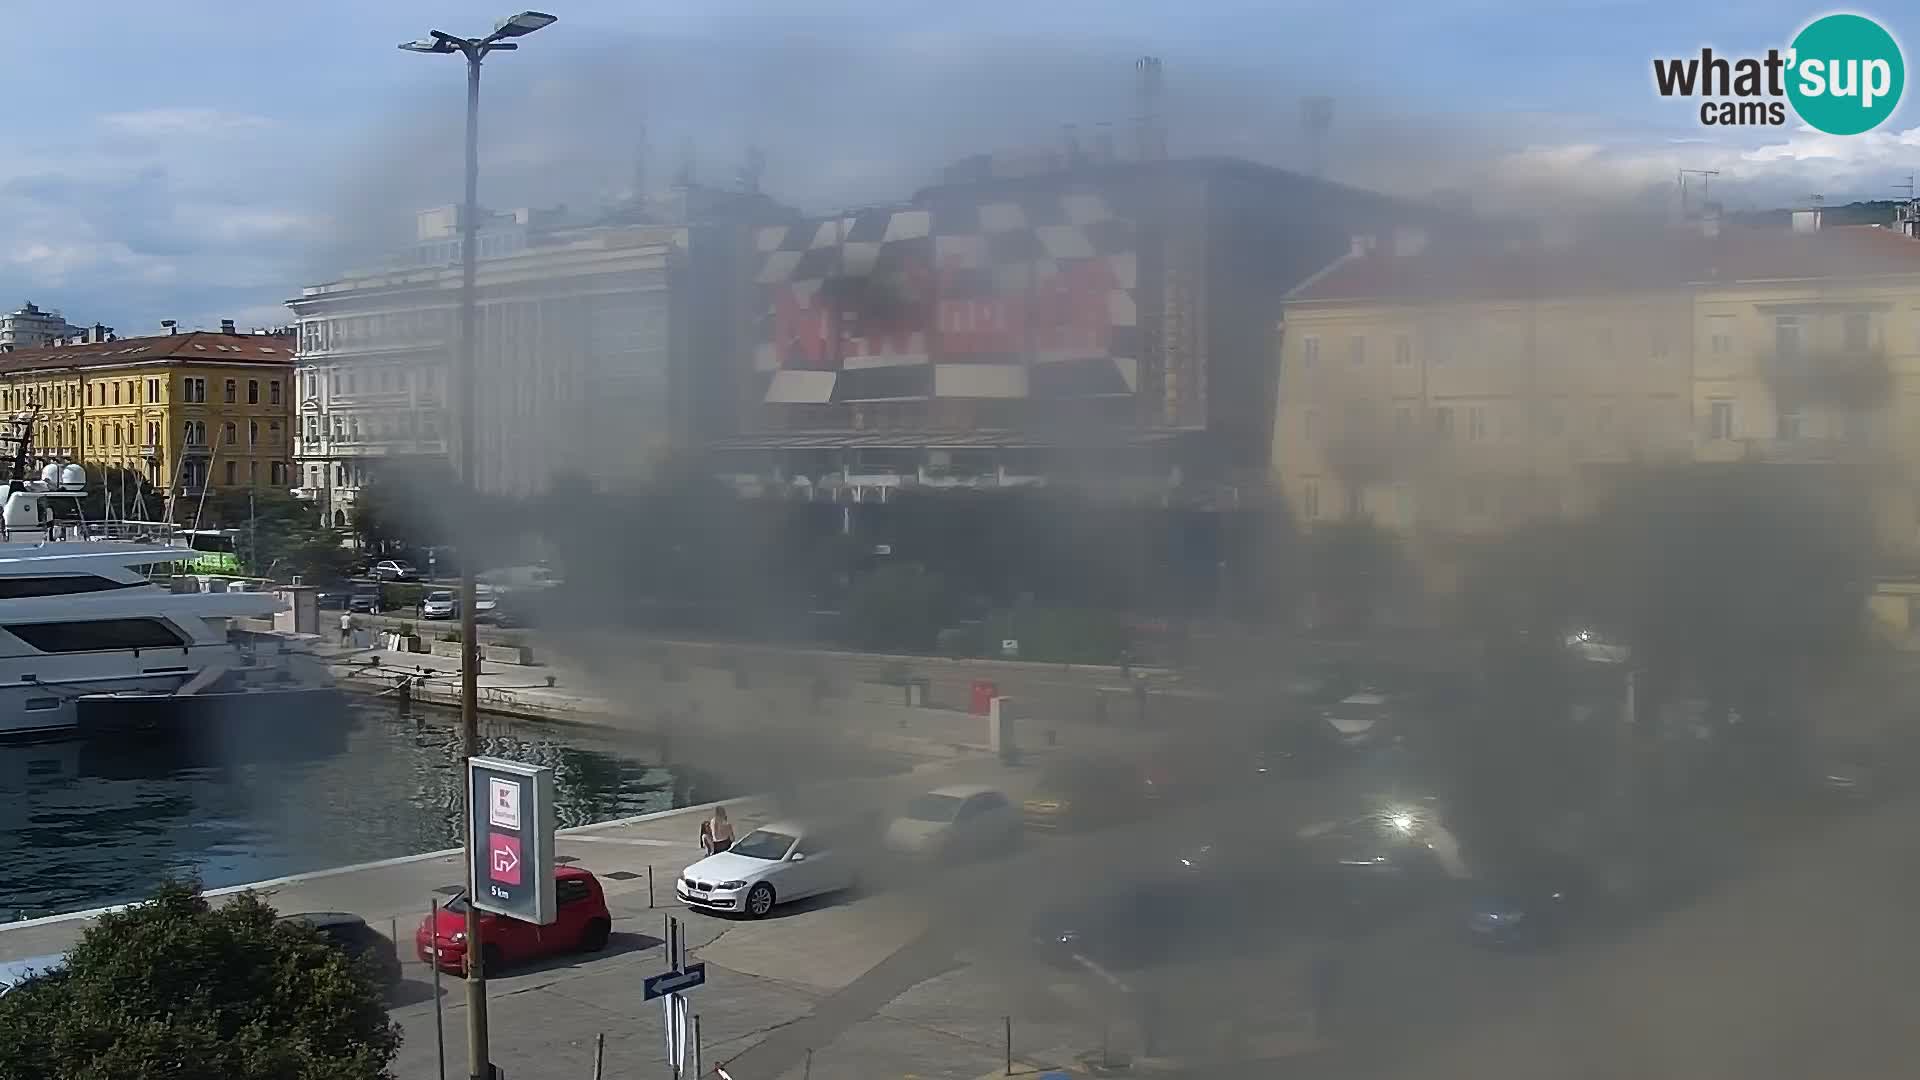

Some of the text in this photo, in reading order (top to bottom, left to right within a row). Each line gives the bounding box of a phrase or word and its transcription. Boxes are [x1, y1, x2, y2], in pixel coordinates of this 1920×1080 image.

[499, 788, 511, 809] K
[491, 885, 509, 899] 5 km
